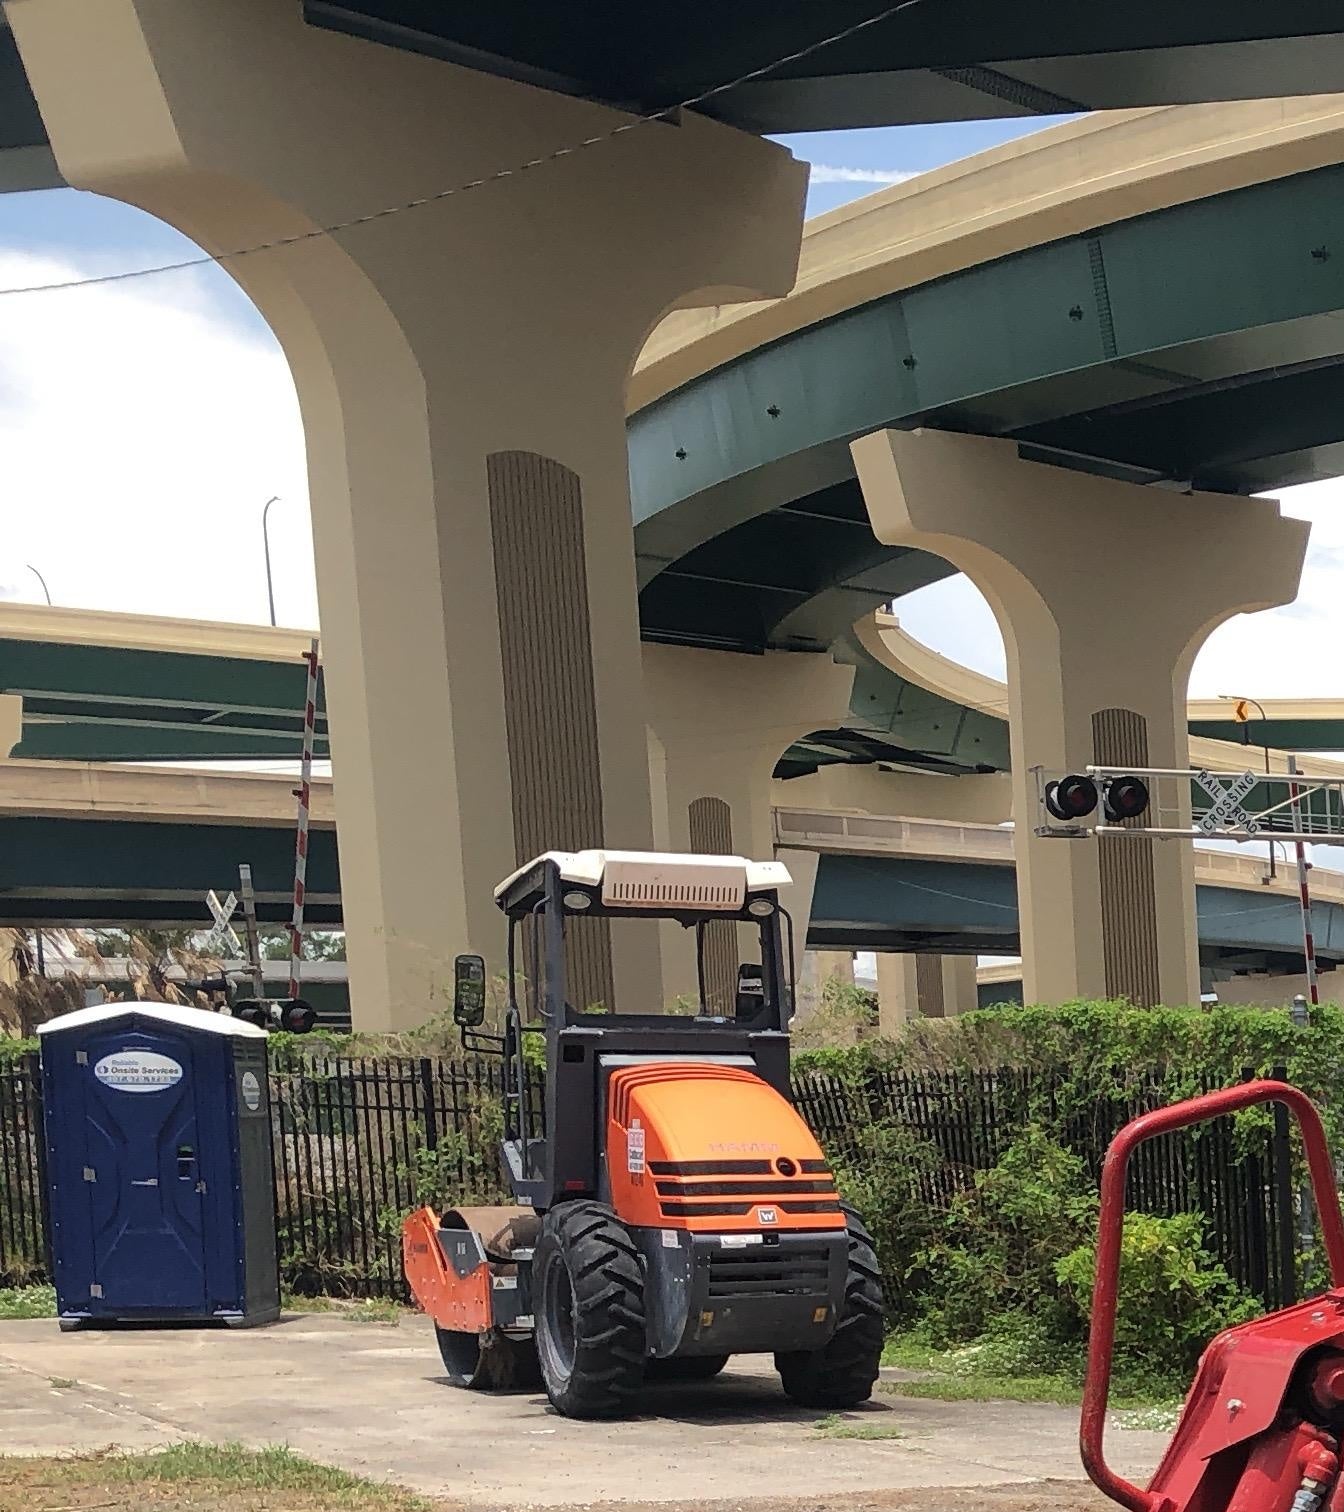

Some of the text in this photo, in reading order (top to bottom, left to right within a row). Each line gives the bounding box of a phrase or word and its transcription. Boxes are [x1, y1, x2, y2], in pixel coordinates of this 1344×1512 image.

[1198, 771, 1258, 833] RAIL ROAD
[1203, 775, 1254, 830] CROSSING
[110, 1066, 179, 1075] Onsite Services
